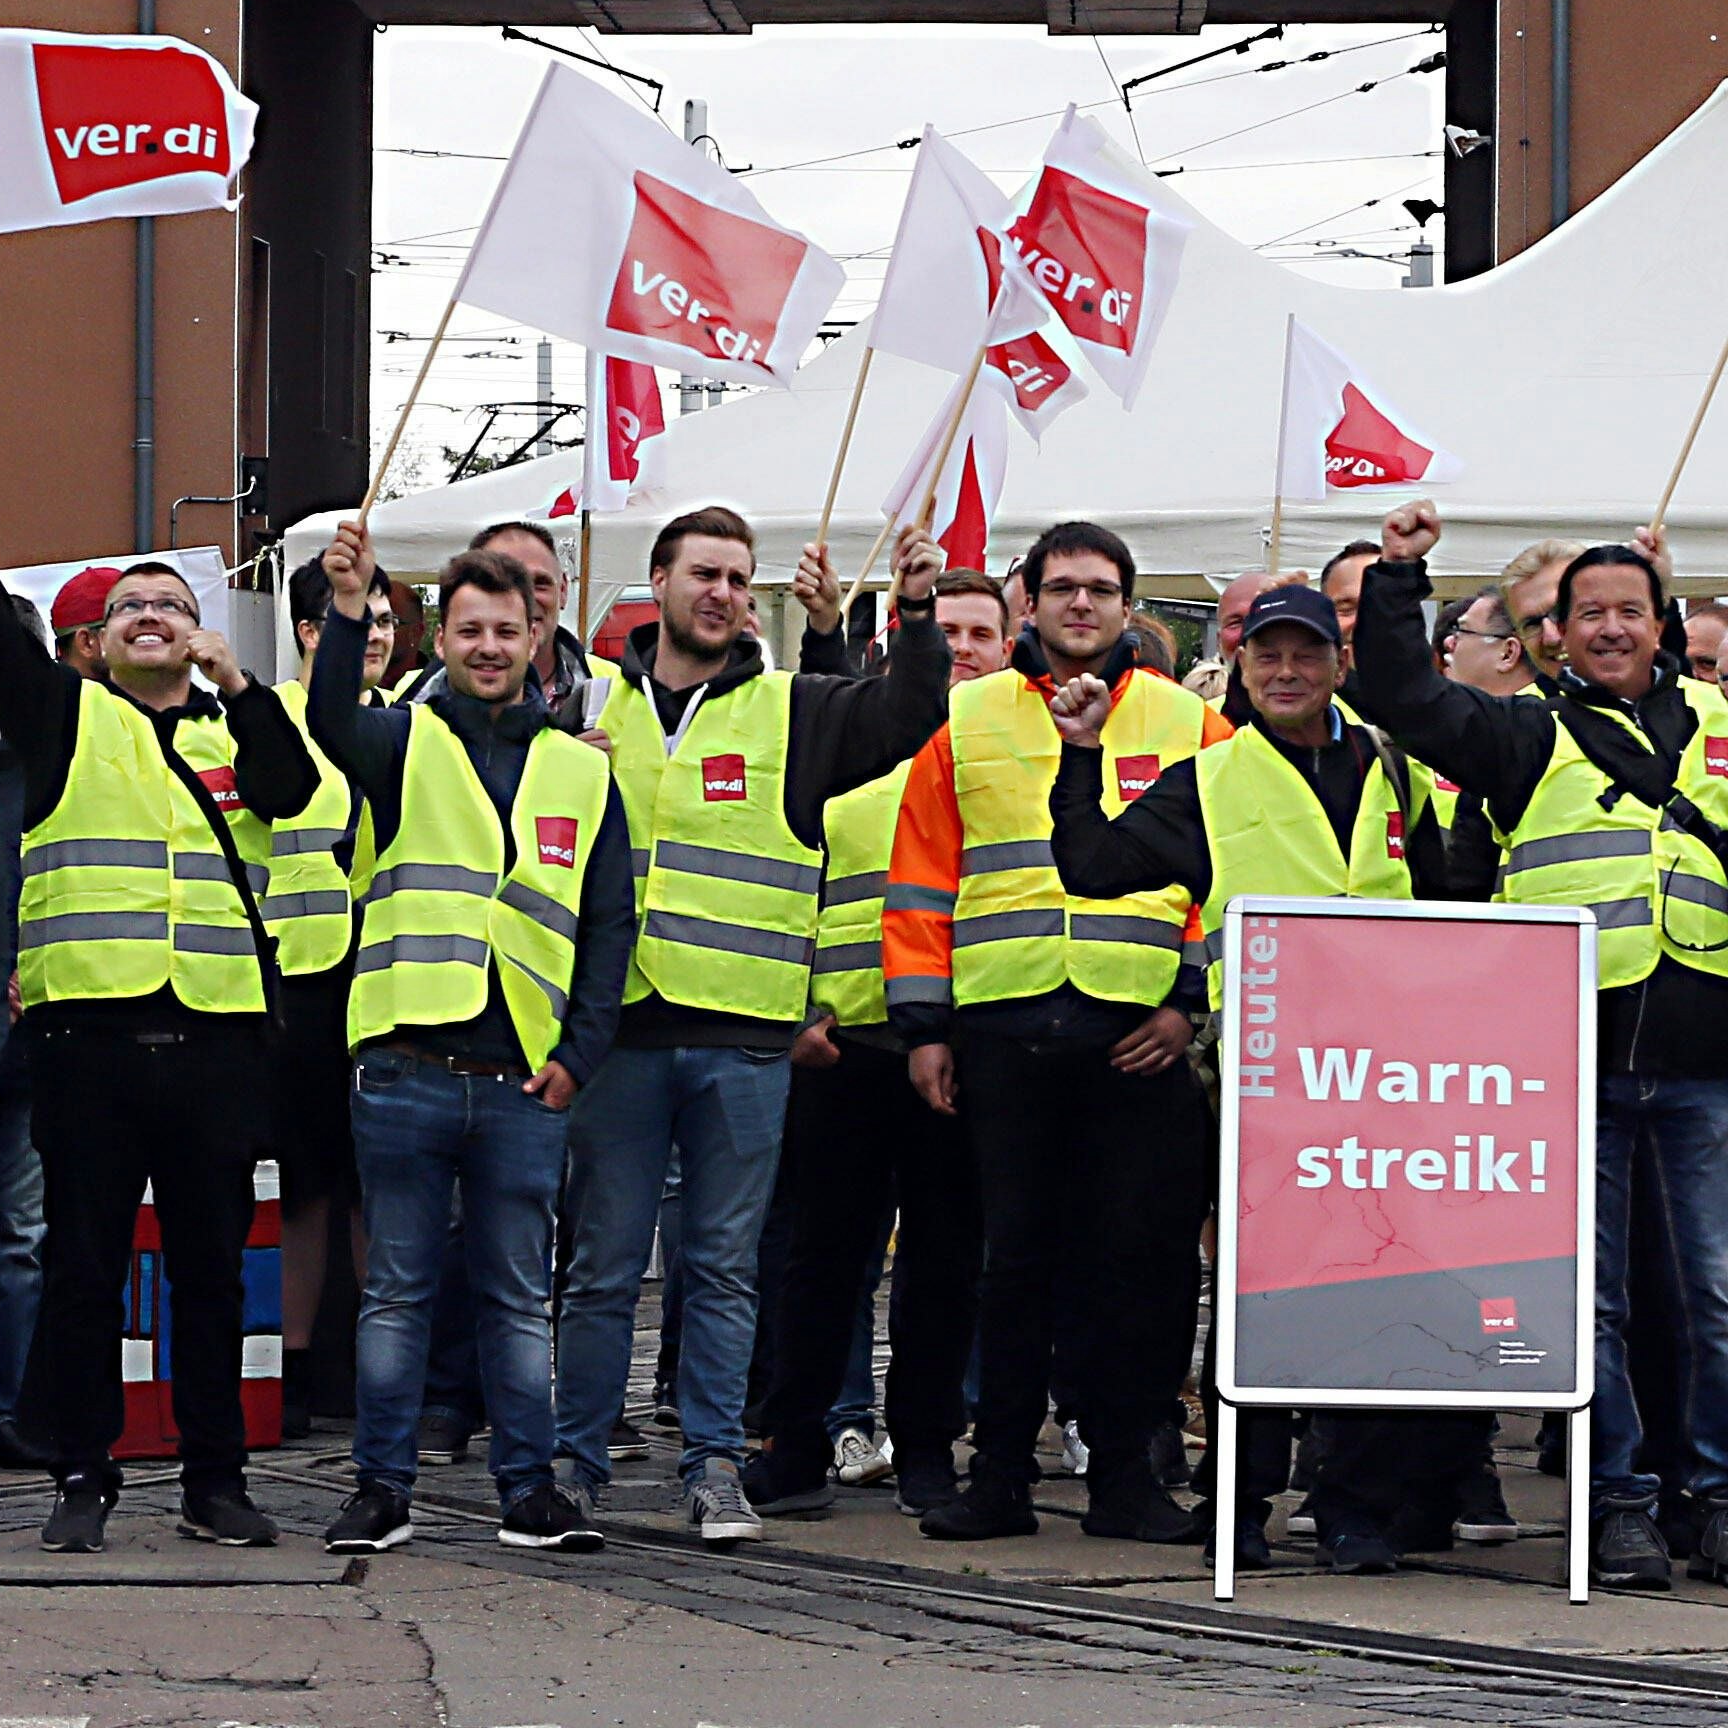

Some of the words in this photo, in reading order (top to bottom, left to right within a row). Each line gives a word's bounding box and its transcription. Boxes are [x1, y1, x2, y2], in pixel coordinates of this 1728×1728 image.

[54, 123, 219, 160] ver.di
[704, 778, 743, 792] ver.di
[1239, 917, 1279, 1098] Heute:
[1296, 1046, 1546, 1106] Warn-
[1295, 1134, 1548, 1194] streik!
